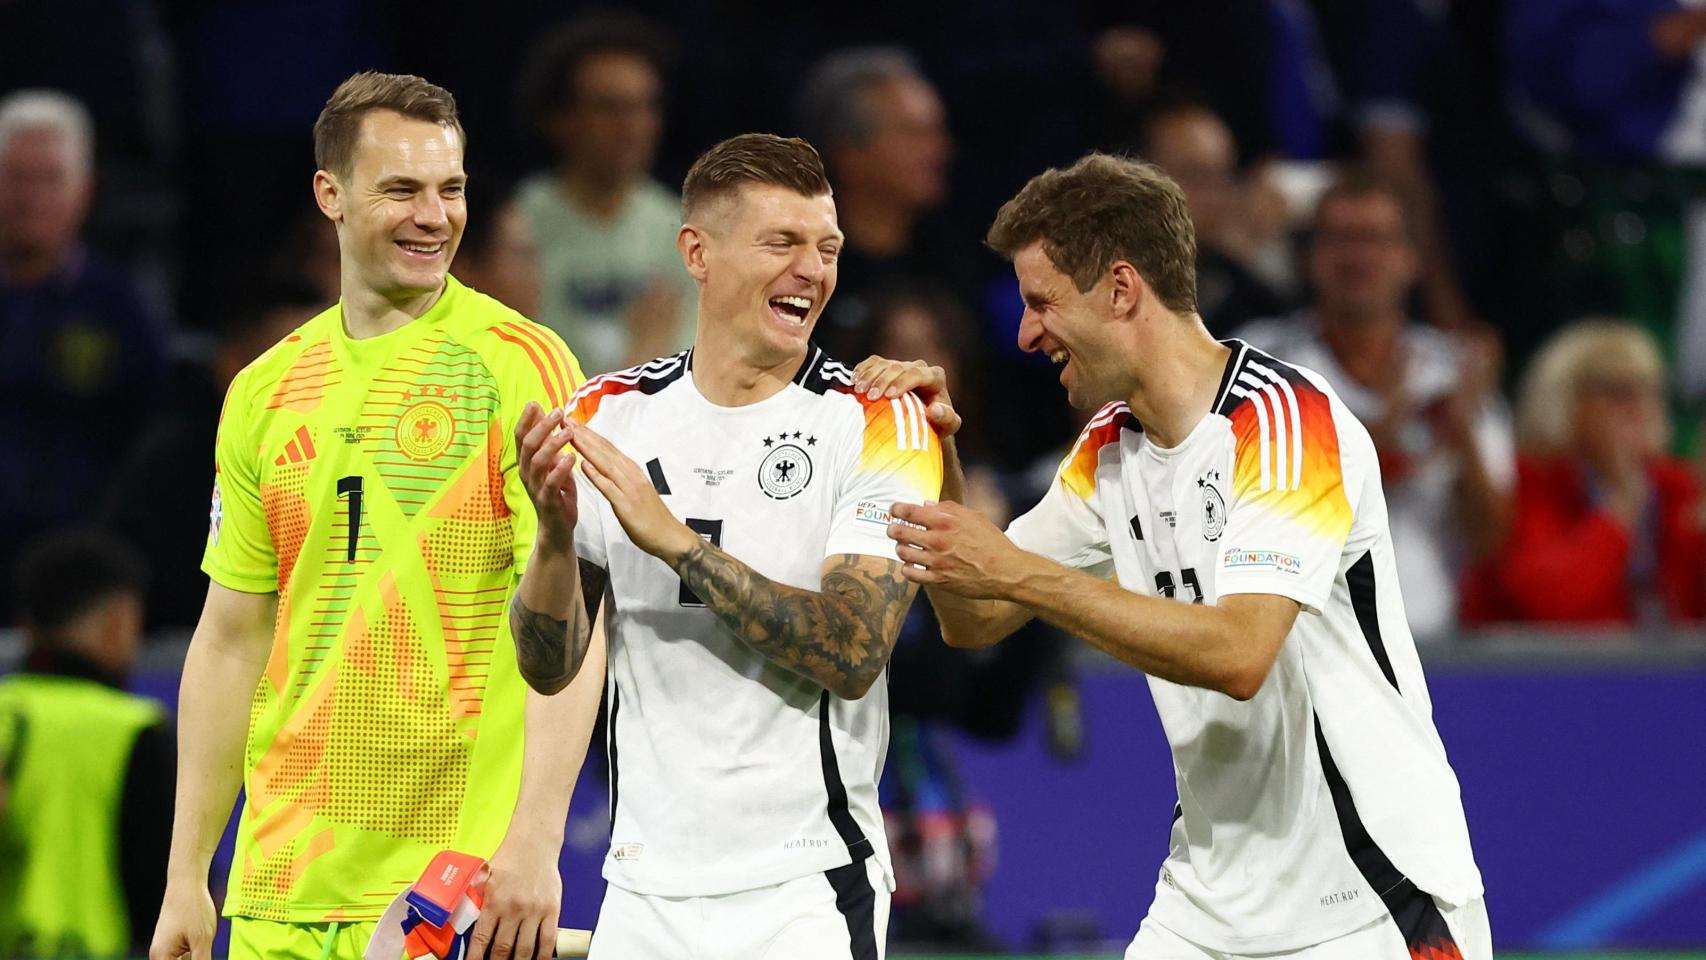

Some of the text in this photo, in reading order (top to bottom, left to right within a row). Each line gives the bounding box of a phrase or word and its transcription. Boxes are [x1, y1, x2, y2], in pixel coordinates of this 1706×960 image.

[857, 501, 876, 509] UEFA
[337, 475, 364, 564] 1
[1224, 553, 1300, 569] FOUNDATION
